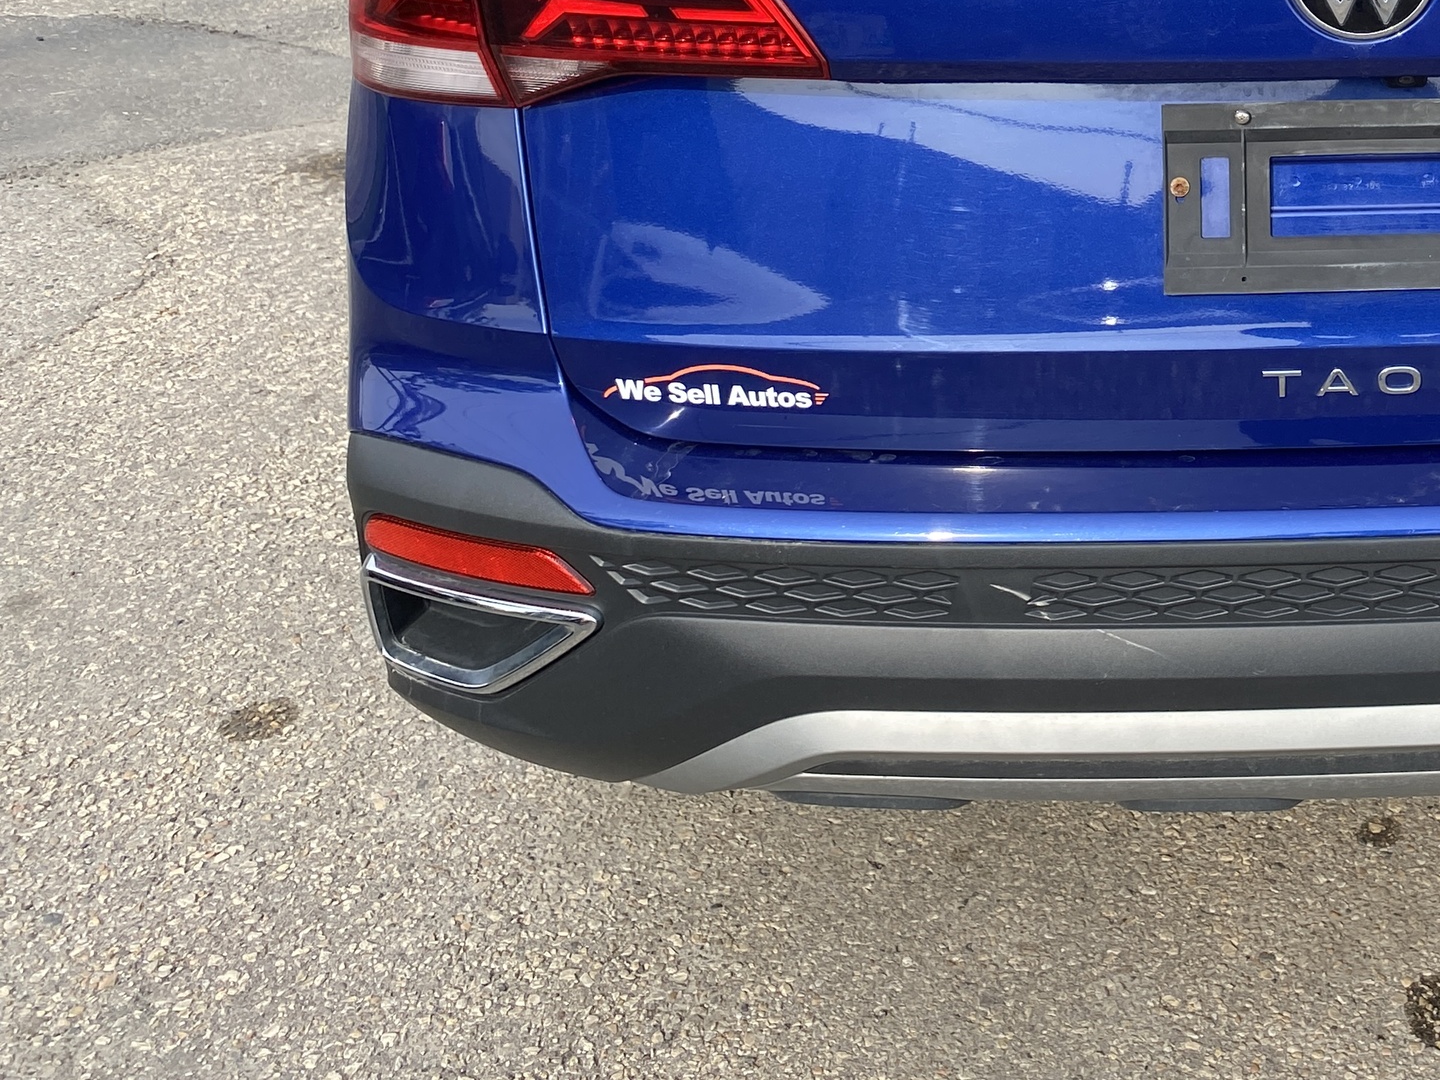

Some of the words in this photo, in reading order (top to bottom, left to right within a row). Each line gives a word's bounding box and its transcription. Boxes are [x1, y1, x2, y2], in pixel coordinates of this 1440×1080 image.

[615, 378, 662, 402] We
[668, 383, 722, 406] Sell
[727, 385, 813, 409] Autos
